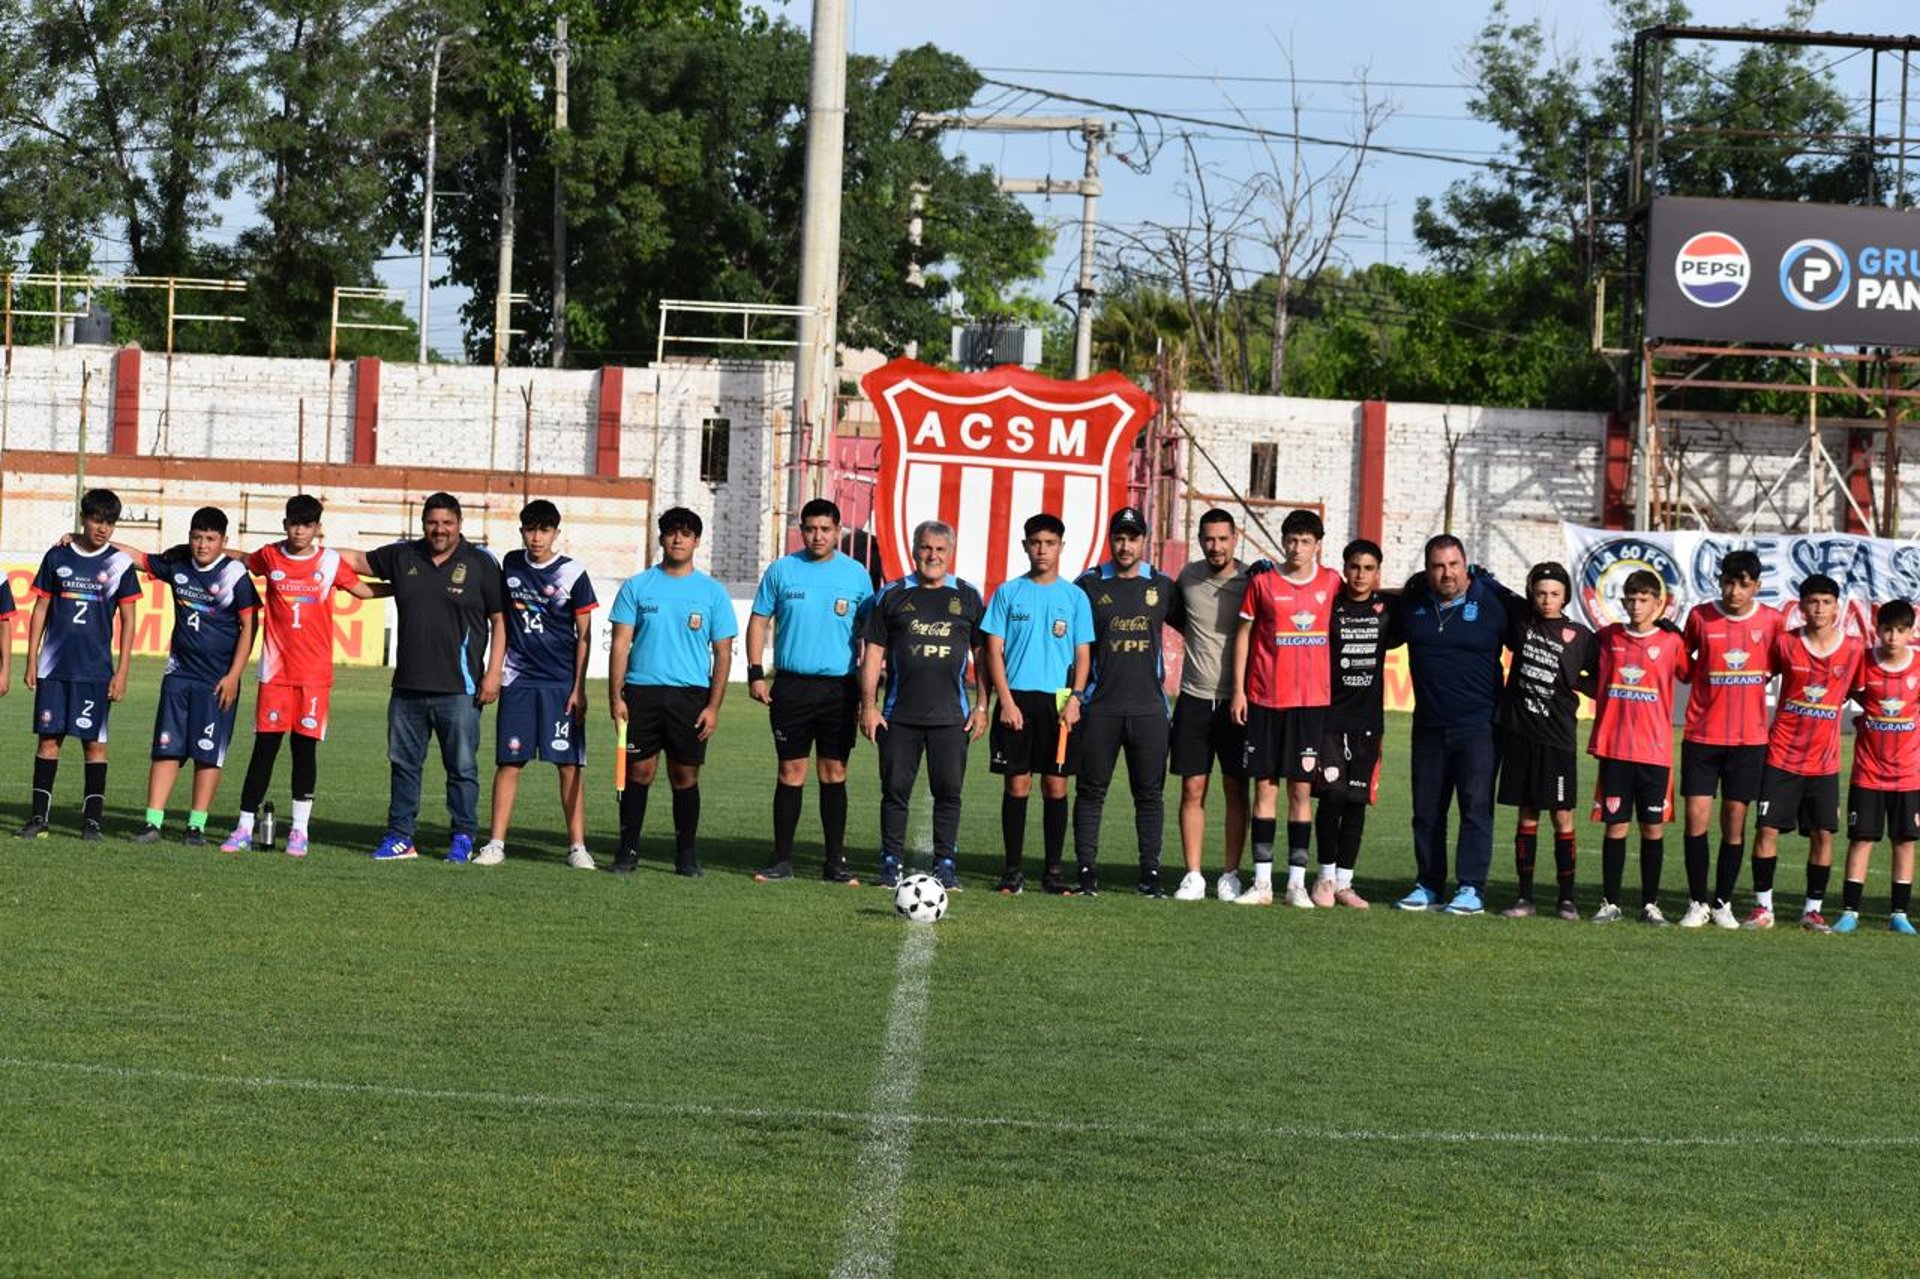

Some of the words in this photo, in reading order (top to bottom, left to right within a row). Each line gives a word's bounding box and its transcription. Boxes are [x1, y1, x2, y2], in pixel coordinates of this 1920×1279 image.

[1681, 260, 1745, 278] PEPSI
[913, 410, 1088, 457] ACSM
[1594, 551, 1618, 573] LA
[1619, 545, 1641, 560] 60
[1643, 550, 1668, 571] FC
[62, 580, 103, 590] CREDICOOP
[72, 601, 89, 625] 2
[187, 611, 200, 631] 4
[291, 602, 302, 629] 1
[521, 611, 544, 634] 14
[1110, 640, 1149, 652] YPF
[1275, 636, 1327, 646] BELGRANO
[909, 644, 952, 658] YPF
[1711, 676, 1763, 685] BELGRANO
[81, 700, 94, 717] 2
[309, 696, 318, 716] 1
[204, 722, 215, 738] 4
[554, 721, 570, 738] 14
